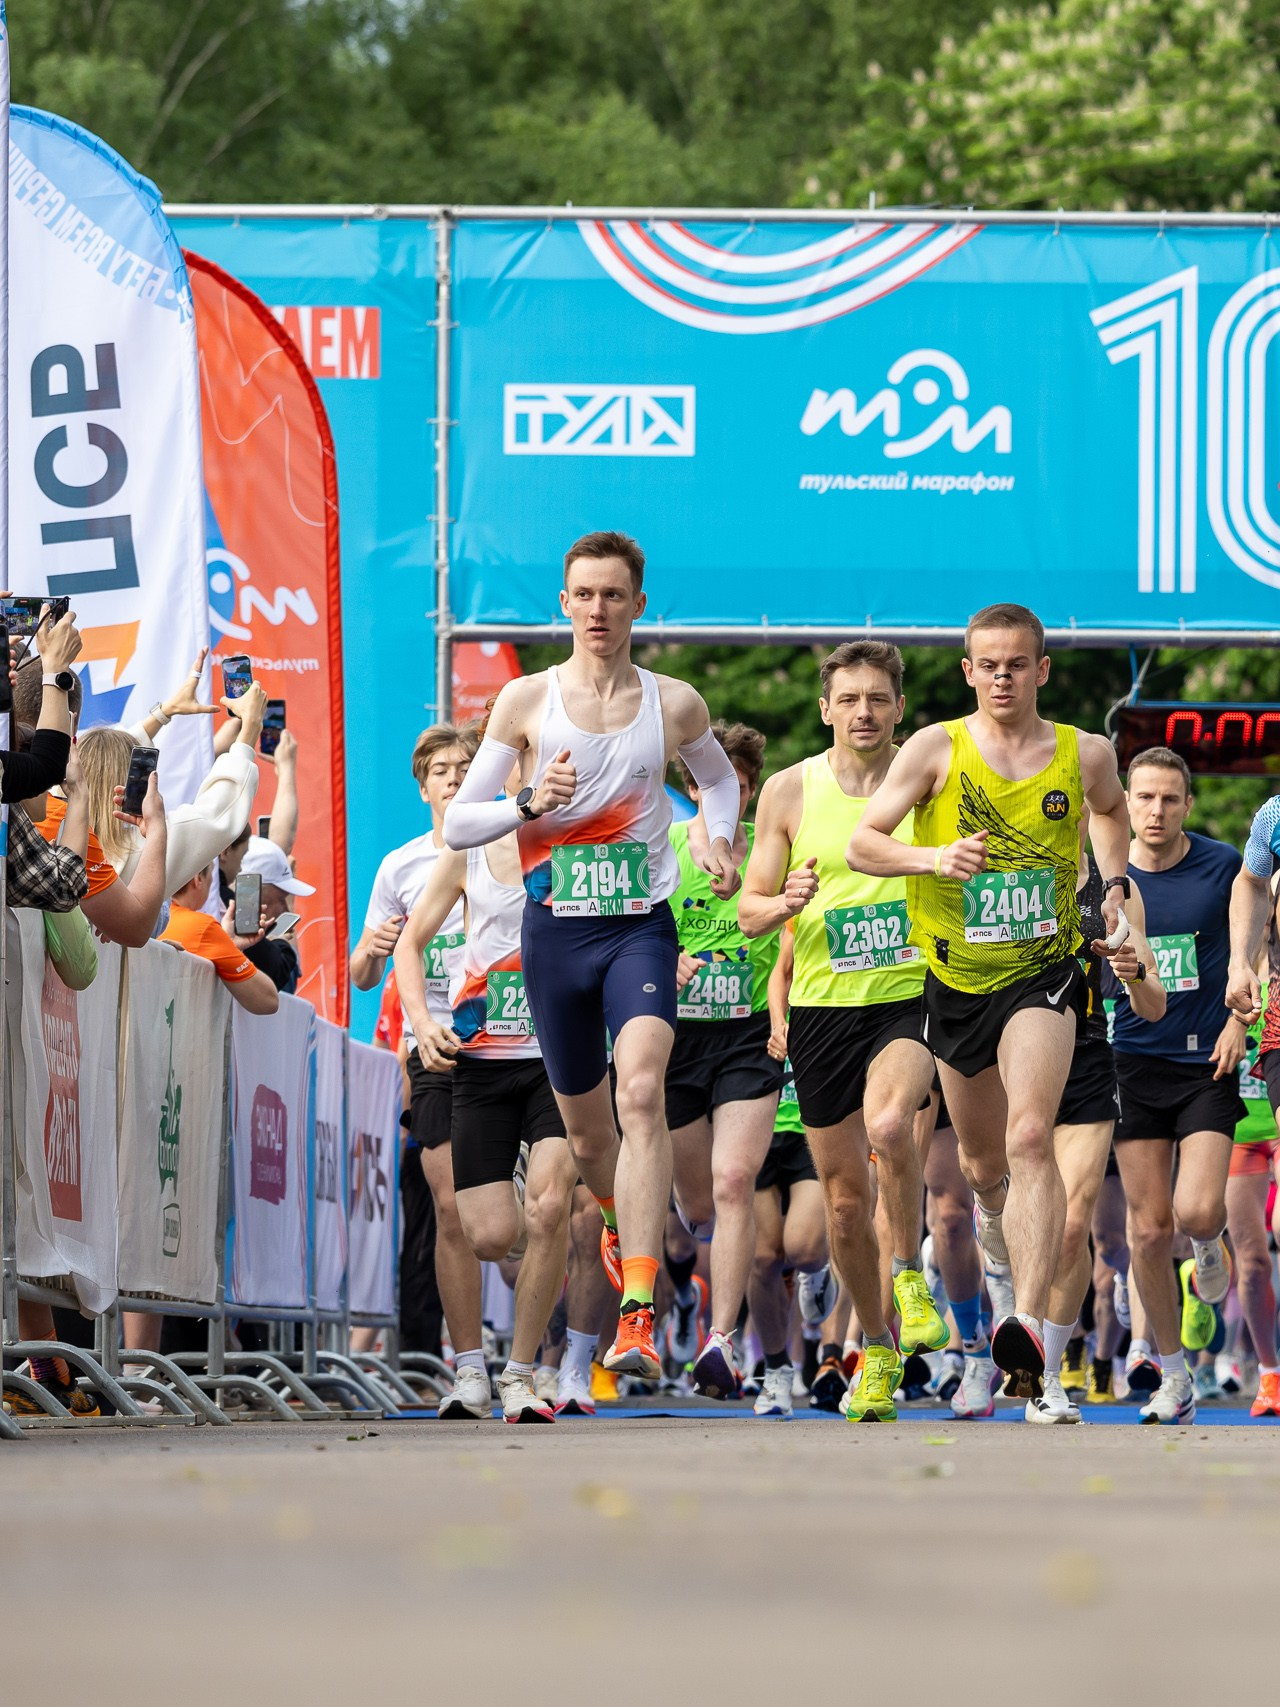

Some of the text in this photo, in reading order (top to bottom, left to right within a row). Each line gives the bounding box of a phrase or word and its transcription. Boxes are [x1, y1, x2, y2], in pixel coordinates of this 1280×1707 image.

[800, 471, 1015, 495] тульский марафон
[571, 860, 632, 897] 2194
[980, 885, 1043, 923] 2404
[675, 917, 738, 932] К-ХОЛДИ
[842, 916, 903, 954] 2362
[1152, 948, 1182, 978] 27
[687, 975, 740, 1004] 2488
